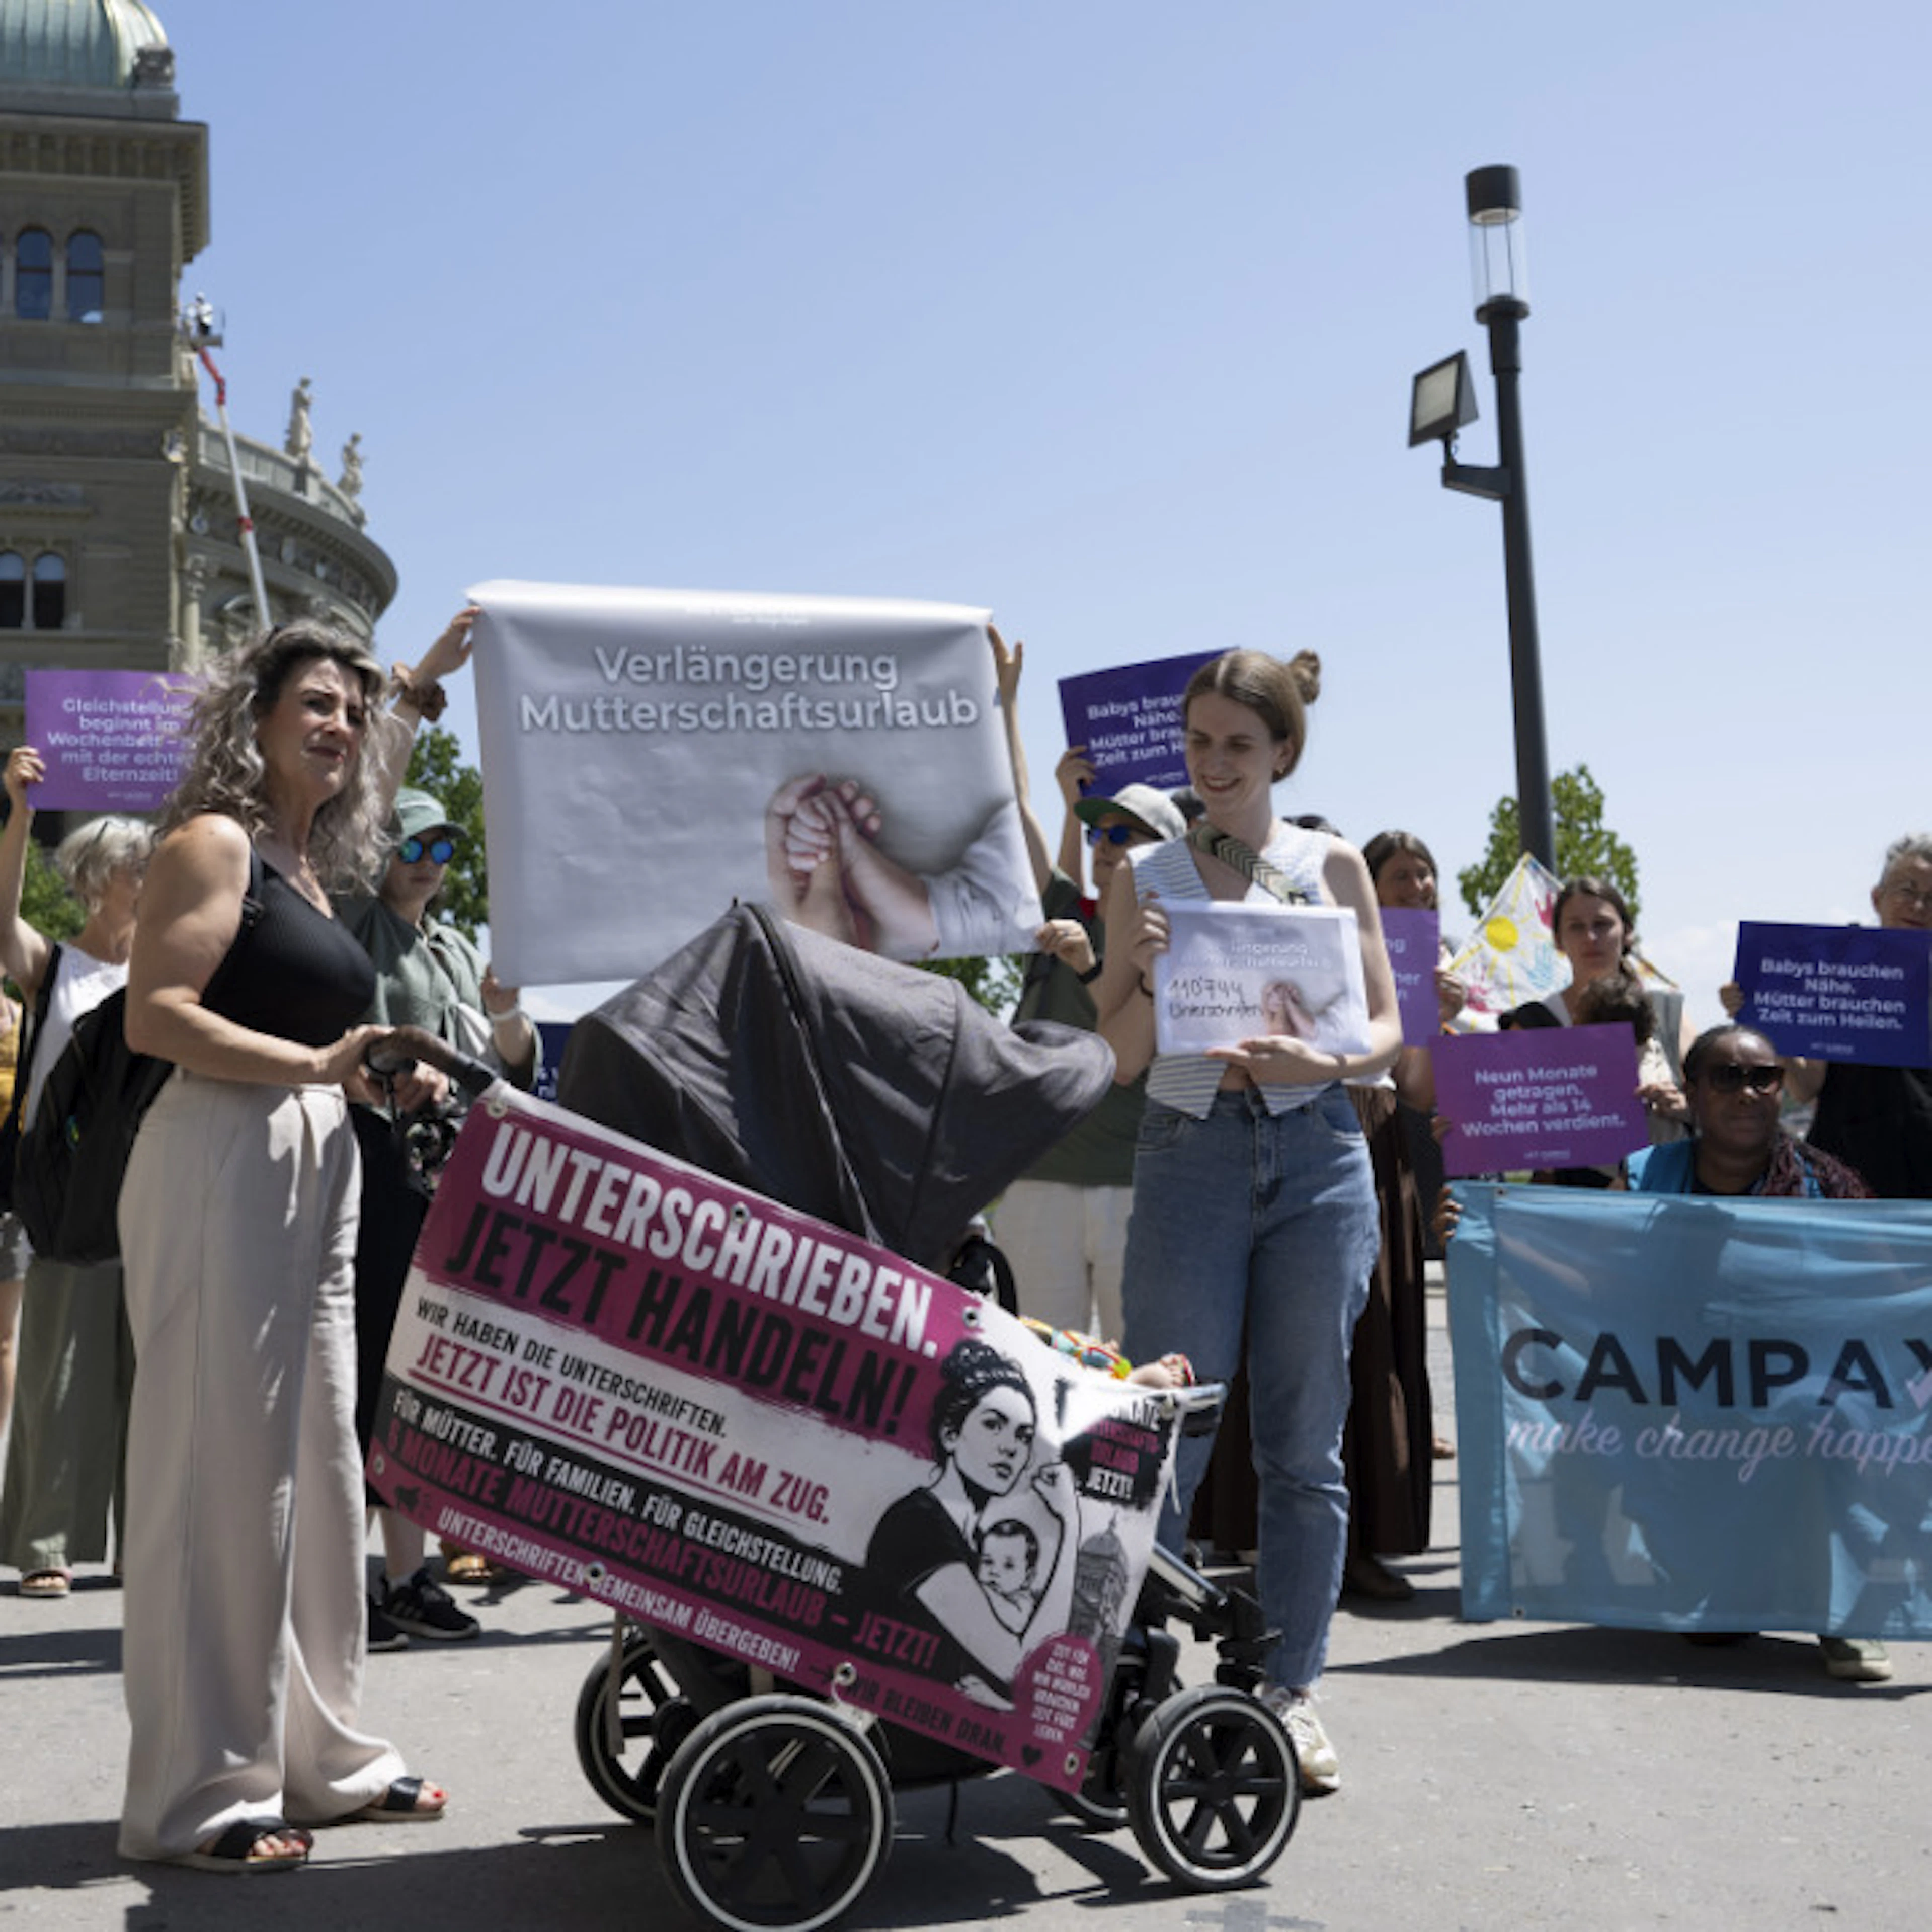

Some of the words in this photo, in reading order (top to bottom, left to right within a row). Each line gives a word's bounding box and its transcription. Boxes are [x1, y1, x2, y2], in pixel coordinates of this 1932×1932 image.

[596, 645, 898, 691] Verlängerung
[520, 690, 978, 733] Mutterschaftsurlaub
[1087, 701, 1139, 721] Babys
[79, 715, 152, 732] beginnt
[155, 715, 180, 731] im
[47, 731, 161, 747] Wochenbett
[1090, 732, 1146, 751] Mütter
[61, 750, 93, 764] mit
[98, 750, 128, 764] der
[1094, 748, 1128, 768] Zeit
[1132, 745, 1168, 761] zum
[1760, 959, 1814, 978] Babys
[1818, 960, 1904, 981] brauchen
[1804, 978, 1857, 995] Nähe.
[1753, 991, 1815, 1007] Mütter
[1818, 995, 1906, 1014] brauchen
[1758, 1008, 1793, 1024] Zeit
[1797, 1012, 1836, 1026] zum
[1839, 1013, 1903, 1030] Heilen.
[1475, 1069, 1524, 1085] Neun
[1527, 1064, 1598, 1081] Monate
[1490, 1102, 1537, 1118] Mehr
[1542, 1100, 1568, 1115] als
[1571, 1097, 1592, 1112] 14
[1461, 1119, 1539, 1138] Wochen
[1543, 1113, 1627, 1132] verdient.
[482, 1123, 937, 1358] UNTERSCHRIEBEN.
[444, 1202, 627, 1324] JETZT
[627, 1270, 918, 1435] HANDELN!
[417, 1298, 448, 1328] WIR
[453, 1312, 520, 1354] HABEN
[523, 1339, 557, 1370] DIE
[560, 1353, 727, 1438] UNTERSCHRIFTEN.
[417, 1333, 502, 1392] JETZT
[500, 1366, 551, 1412] IST
[552, 1387, 605, 1434] DIE
[606, 1407, 718, 1479] POLITIK
[717, 1452, 768, 1496] AM
[769, 1471, 830, 1524] ZUG.
[1508, 1406, 1623, 1453] make
[1635, 1410, 1795, 1482] change
[393, 1390, 420, 1423] FÜR
[421, 1406, 498, 1460] MÜTTER.
[504, 1439, 544, 1477] FÜR
[544, 1456, 636, 1515] FAMILIEN.
[640, 1492, 683, 1531] FÜR
[683, 1511, 843, 1595] GLEICHSTELLUNG.
[401, 1429, 505, 1504] MONATE
[507, 1475, 828, 1627] MUTTERSCHAFTSURLAUB
[852, 1613, 942, 1670] JETZT!
[437, 1506, 584, 1586] UNTERSCHRIFTEN
[694, 1605, 801, 1673] ÜBERGEBEN!
[849, 1677, 879, 1704] WIR
[882, 1688, 953, 1734] BLEIBEN
